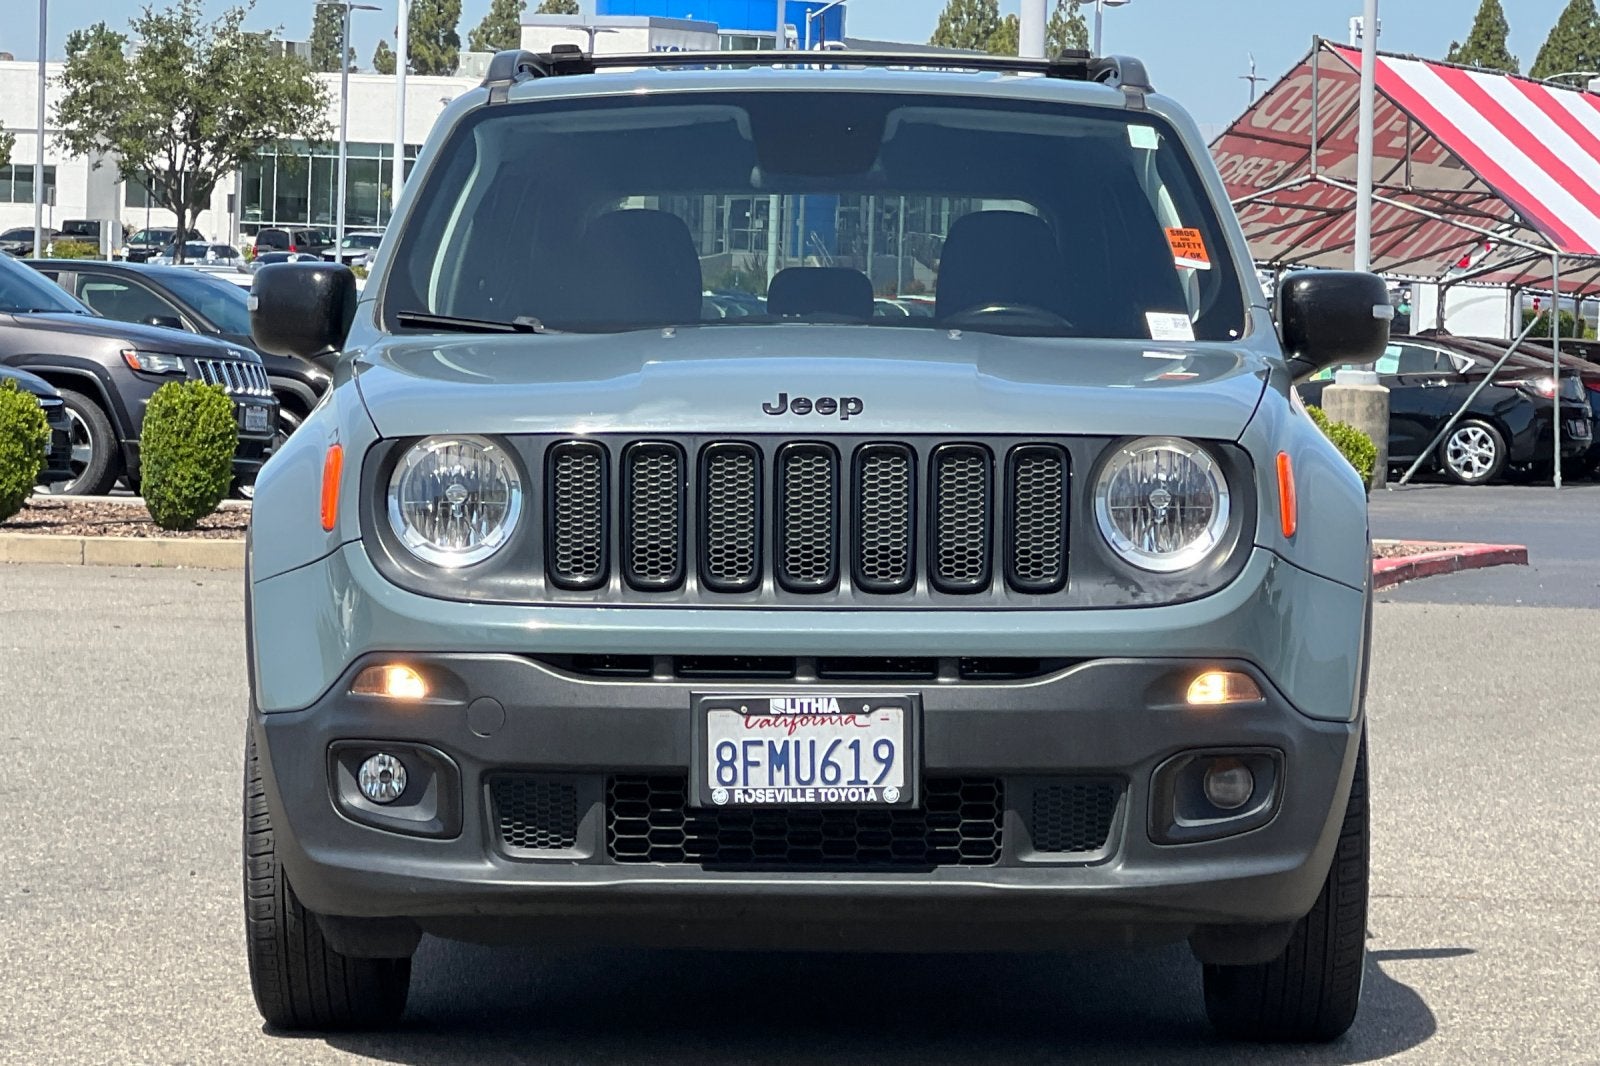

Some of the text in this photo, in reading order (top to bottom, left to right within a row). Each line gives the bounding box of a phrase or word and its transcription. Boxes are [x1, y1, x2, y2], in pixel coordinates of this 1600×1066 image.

[1169, 229, 1196, 237] SMOG
[1171, 241, 1202, 249] SAFETY
[762, 393, 864, 421] Jeep
[786, 698, 840, 714] LITHIA
[744, 713, 870, 736] California
[716, 738, 895, 787] 8FMU619
[734, 788, 877, 803] ROSEVILLE TOYOTA
